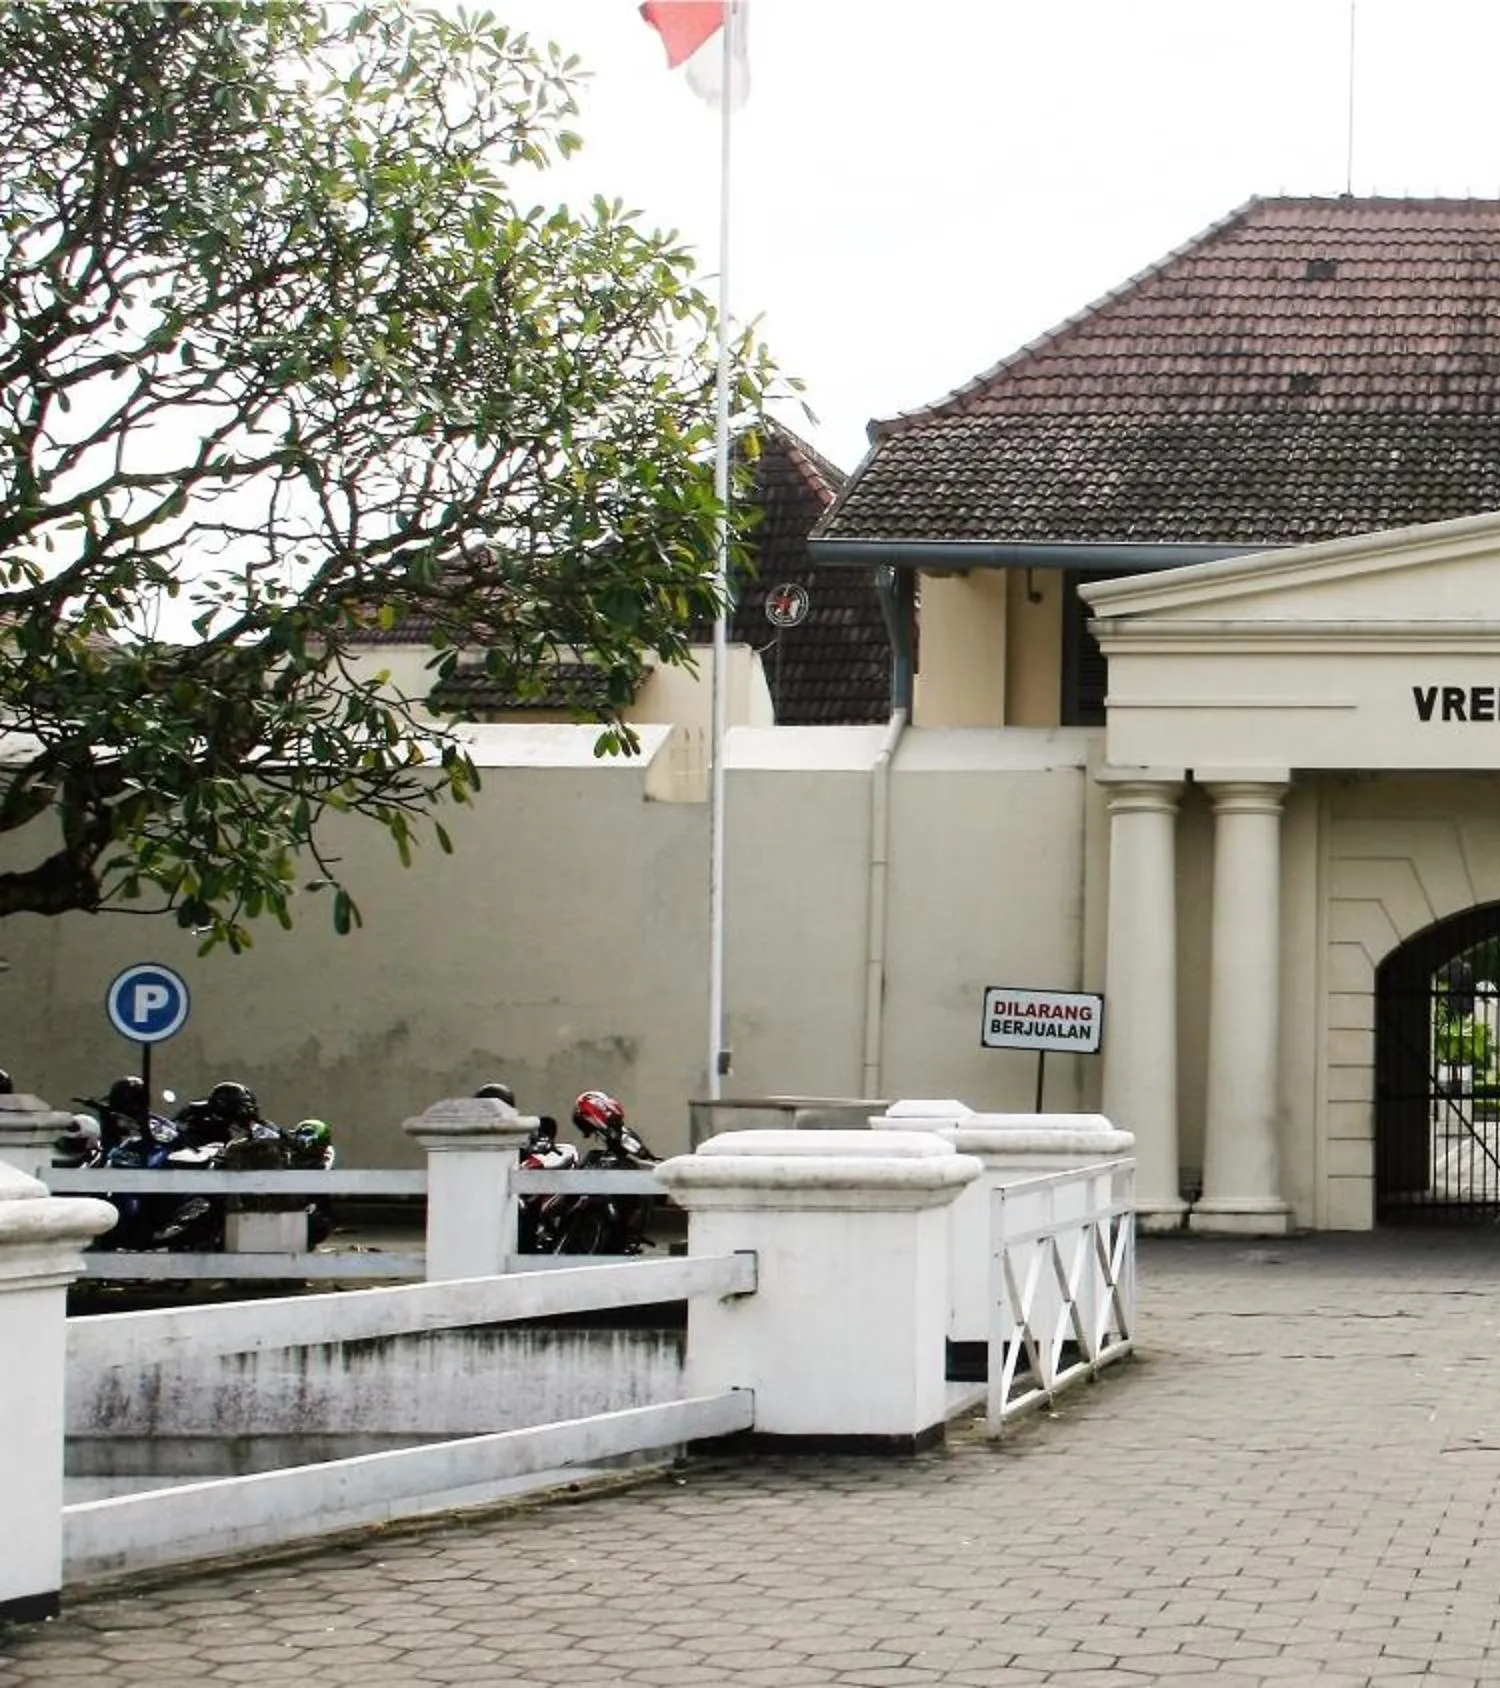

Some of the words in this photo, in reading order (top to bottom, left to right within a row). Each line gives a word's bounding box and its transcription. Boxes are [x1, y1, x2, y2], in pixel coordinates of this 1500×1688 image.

[134, 984, 169, 1023] P
[994, 1001, 1092, 1021] DILARANG
[991, 1019, 1091, 1039] BERJUALAN
